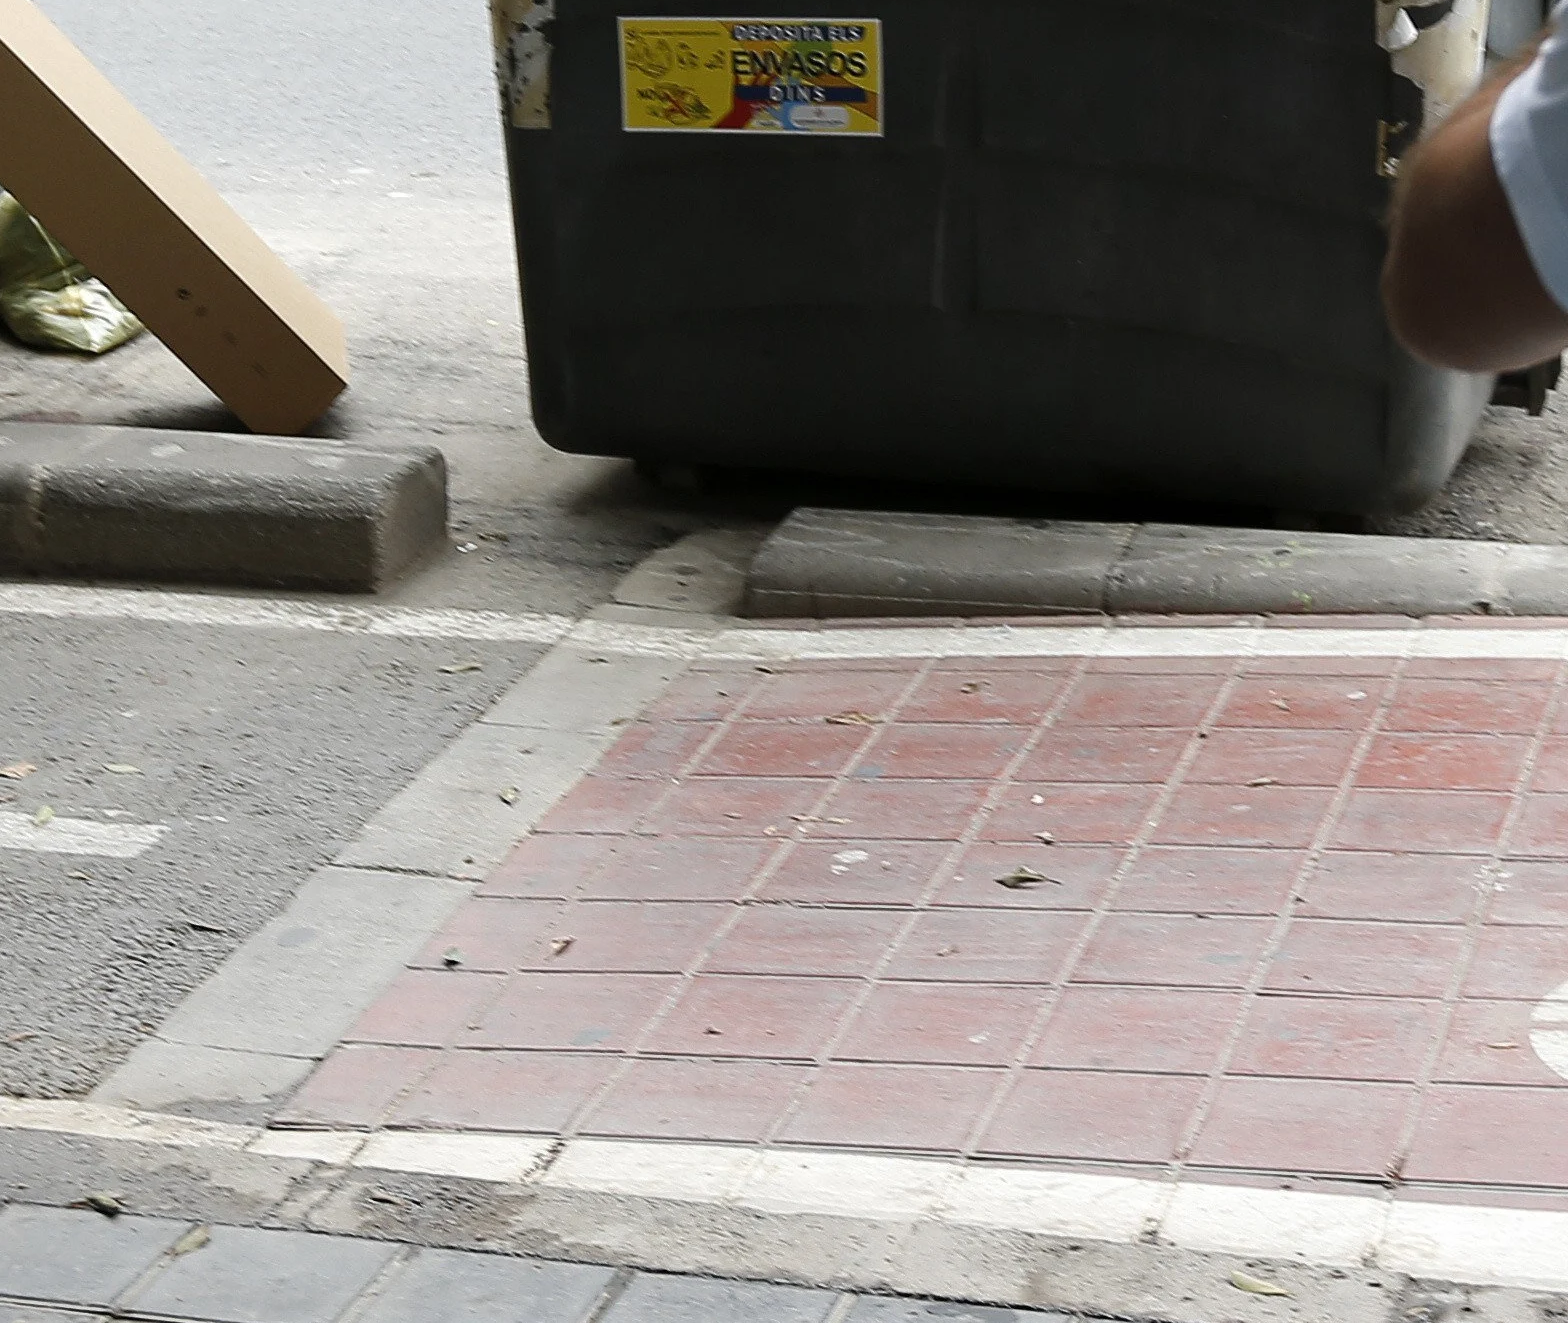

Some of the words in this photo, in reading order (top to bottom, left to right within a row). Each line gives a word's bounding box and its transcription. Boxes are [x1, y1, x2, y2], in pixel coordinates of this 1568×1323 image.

[733, 24, 824, 42] DEPOSITA
[826, 25, 864, 43] ELS
[732, 50, 868, 79] ENVASOS
[769, 85, 827, 104] DINS
